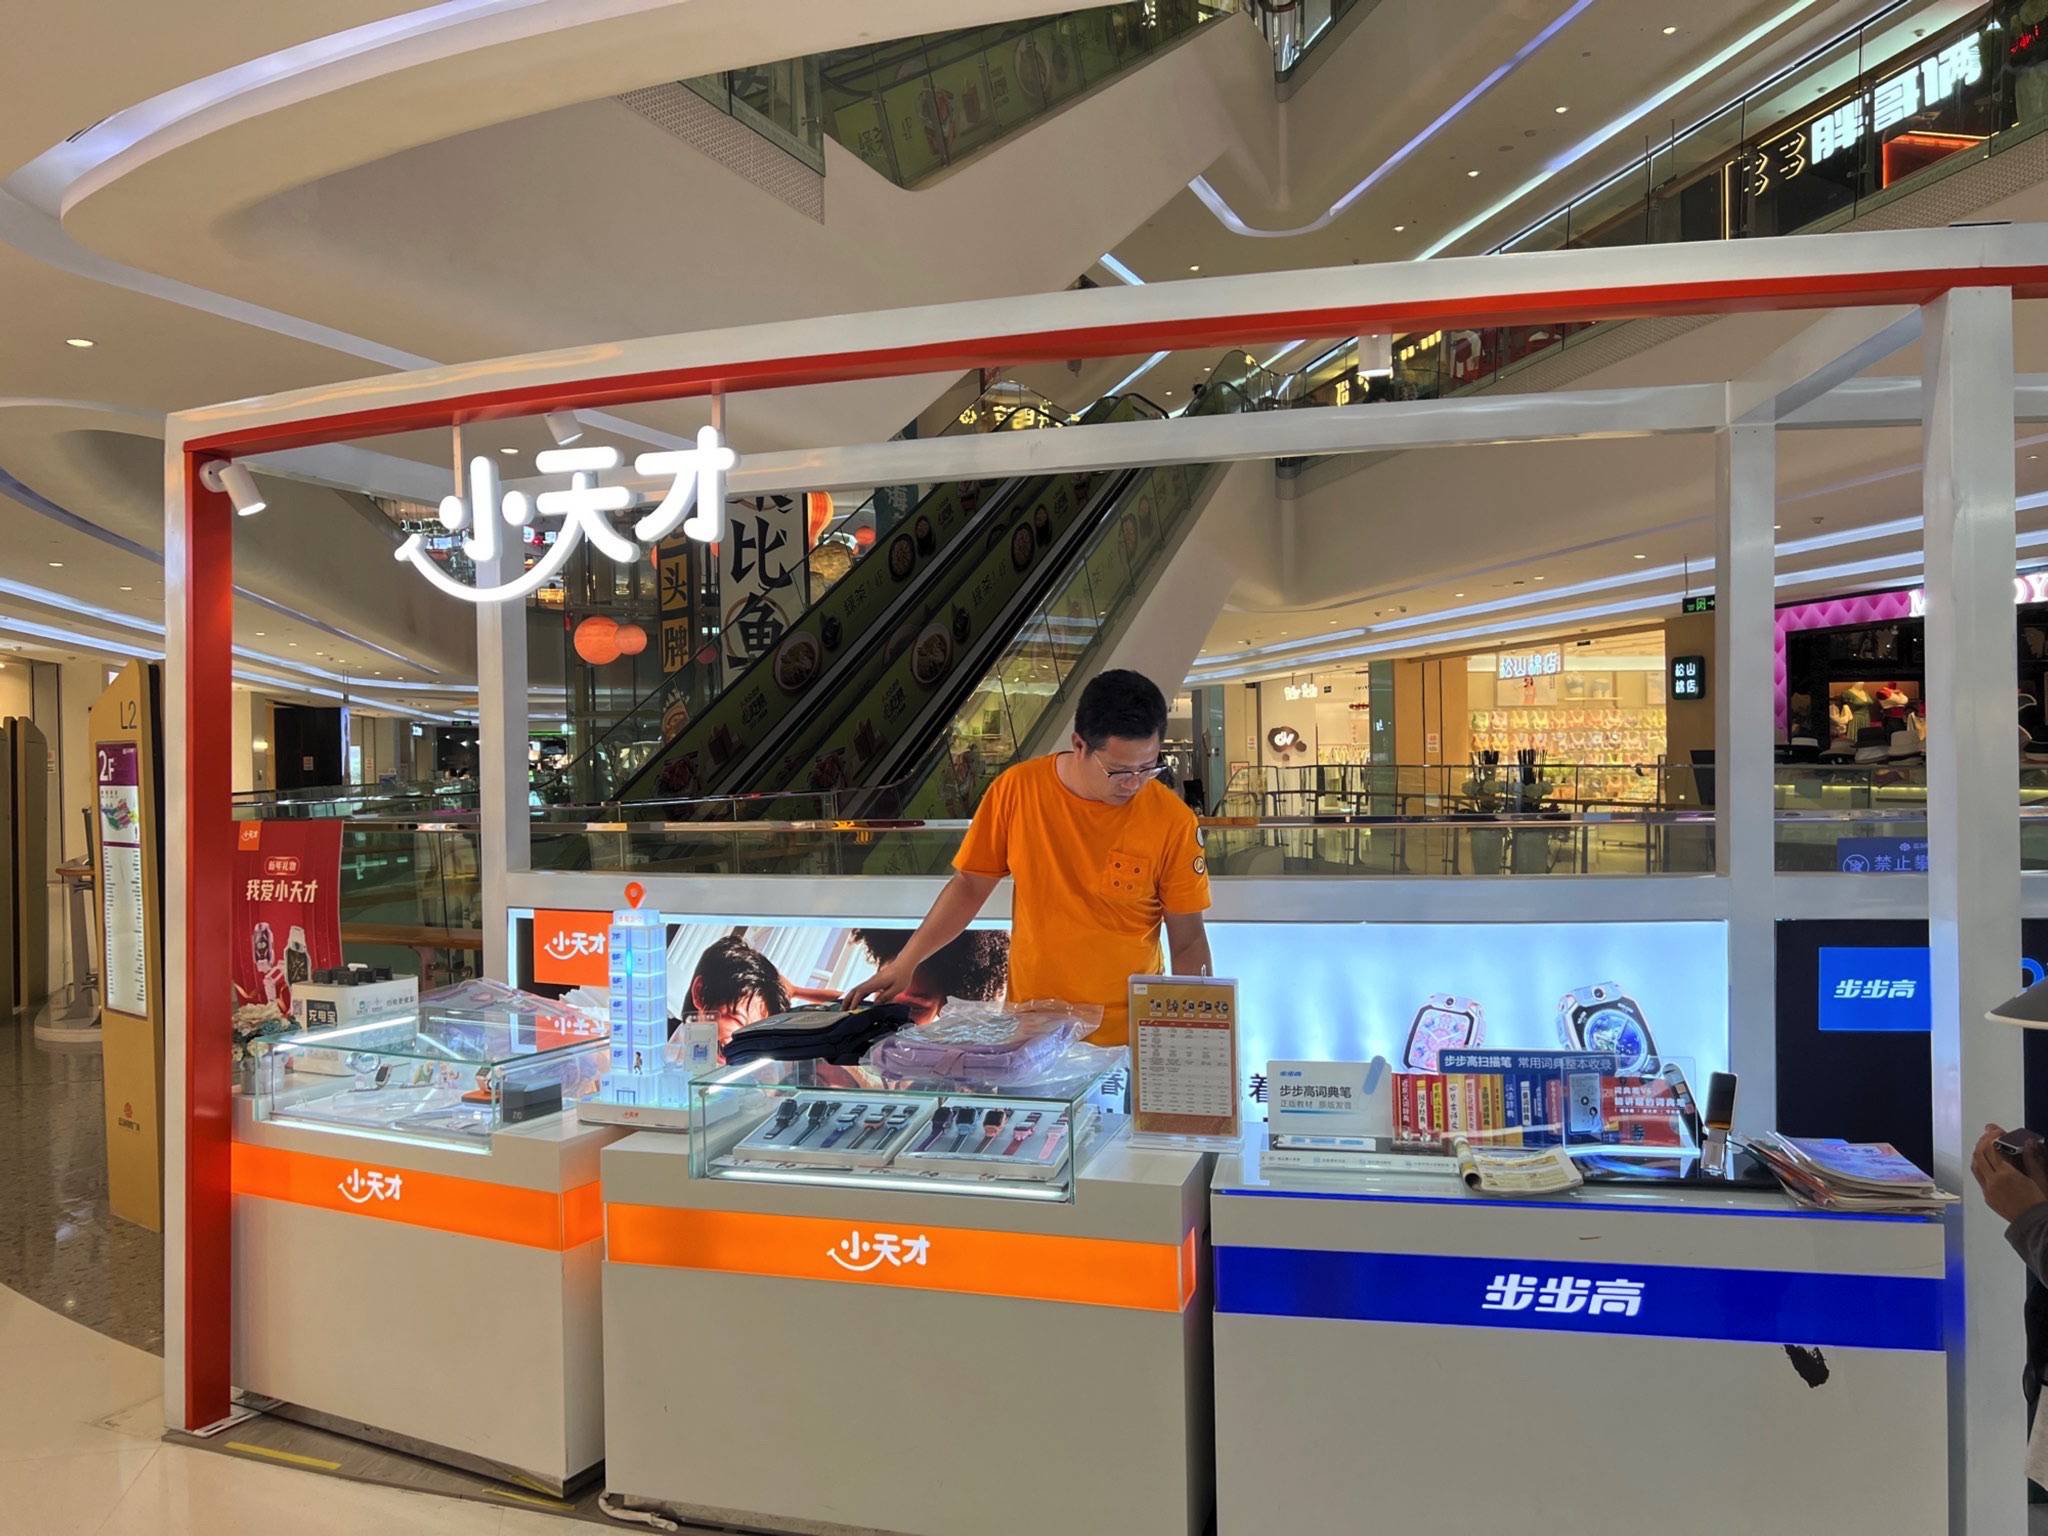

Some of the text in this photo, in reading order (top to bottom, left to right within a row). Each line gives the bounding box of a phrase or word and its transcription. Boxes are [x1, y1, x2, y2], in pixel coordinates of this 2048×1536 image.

[393, 424, 739, 604] 小天才
[726, 494, 794, 669] 比鱼
[1500, 652, 1561, 678] 松山棉店
[120, 701, 137, 729] L2
[98, 750, 115, 781] 2F
[246, 879, 318, 903] 我爱小天才
[543, 931, 606, 960] 小天才
[1834, 978, 1917, 999] 步步高
[1444, 1055, 1613, 1071] 步步高扫描笔 常用词典整本收录
[1279, 1085, 1352, 1098] 步步高词典笔
[1280, 1100, 1313, 1109] 正版教材
[338, 1168, 403, 1204] 小天才
[827, 1231, 931, 1272] 小天才
[1481, 1273, 1646, 1317] 步步高
